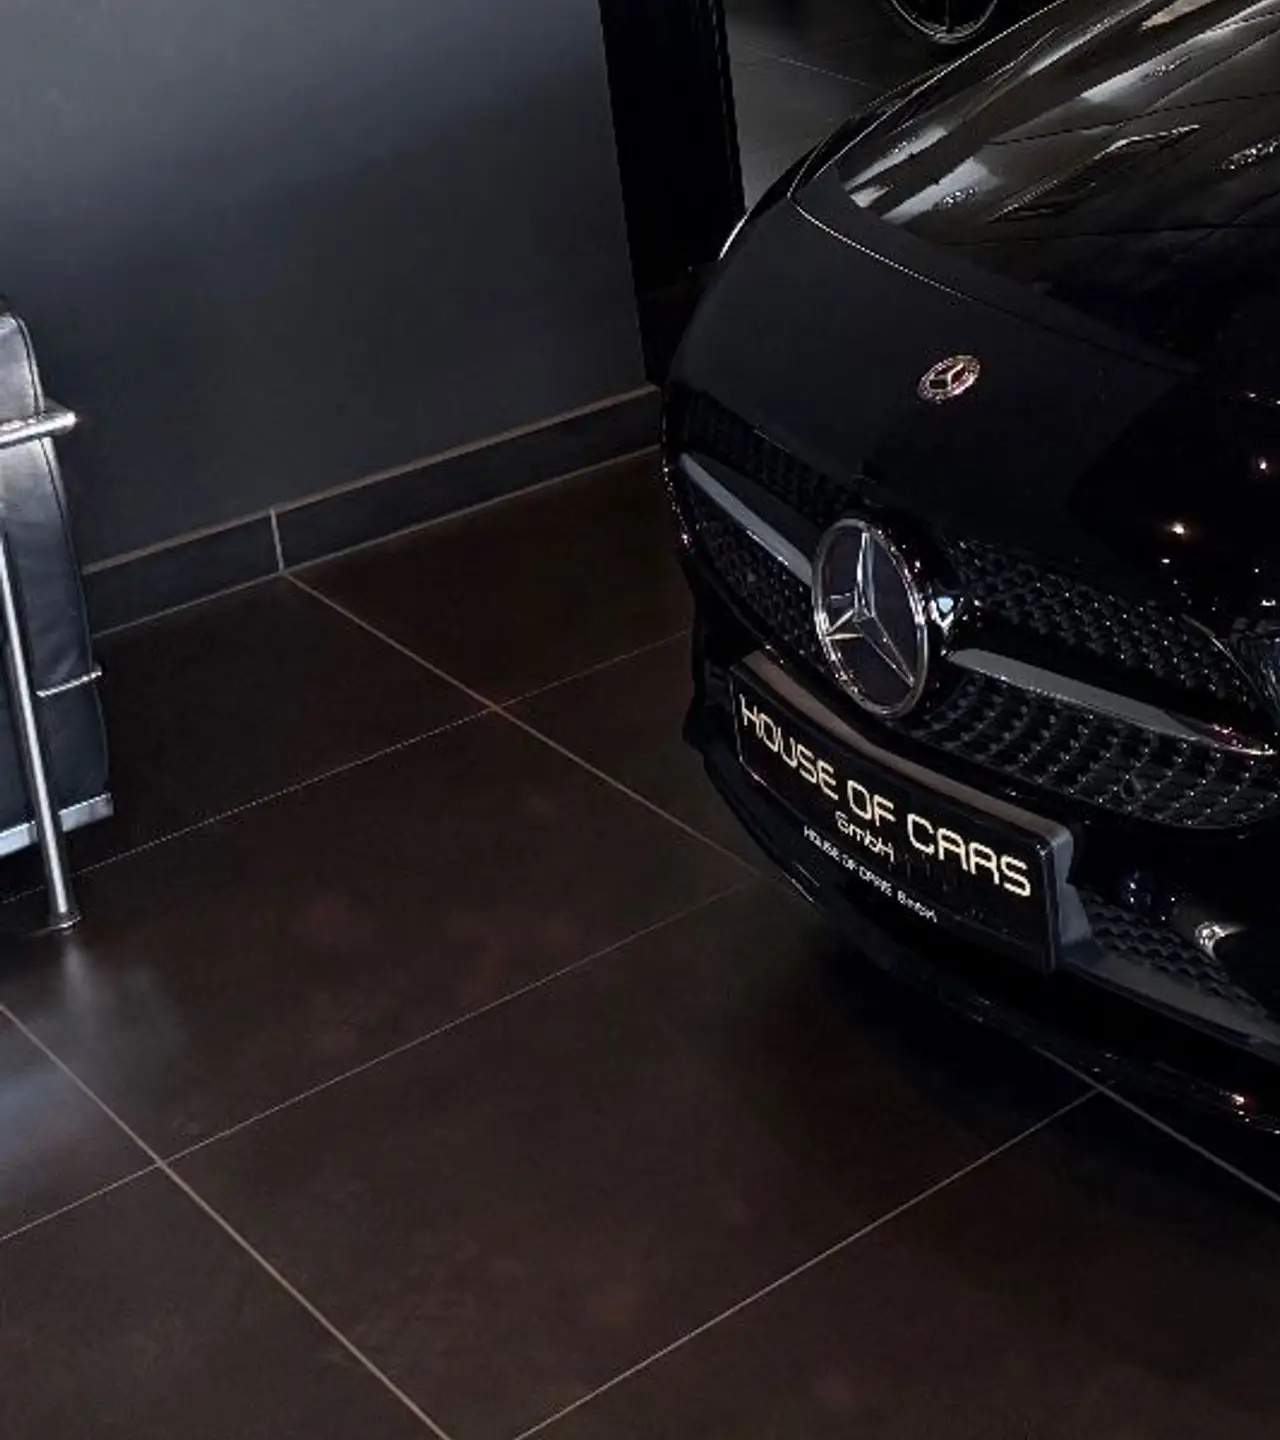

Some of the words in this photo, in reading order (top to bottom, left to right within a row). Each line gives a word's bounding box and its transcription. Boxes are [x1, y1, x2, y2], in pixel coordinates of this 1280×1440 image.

[739, 693, 839, 800] HOUSE
[847, 779, 897, 827] OF
[907, 813, 1031, 897] CARS
[835, 810, 895, 862] GmbH
